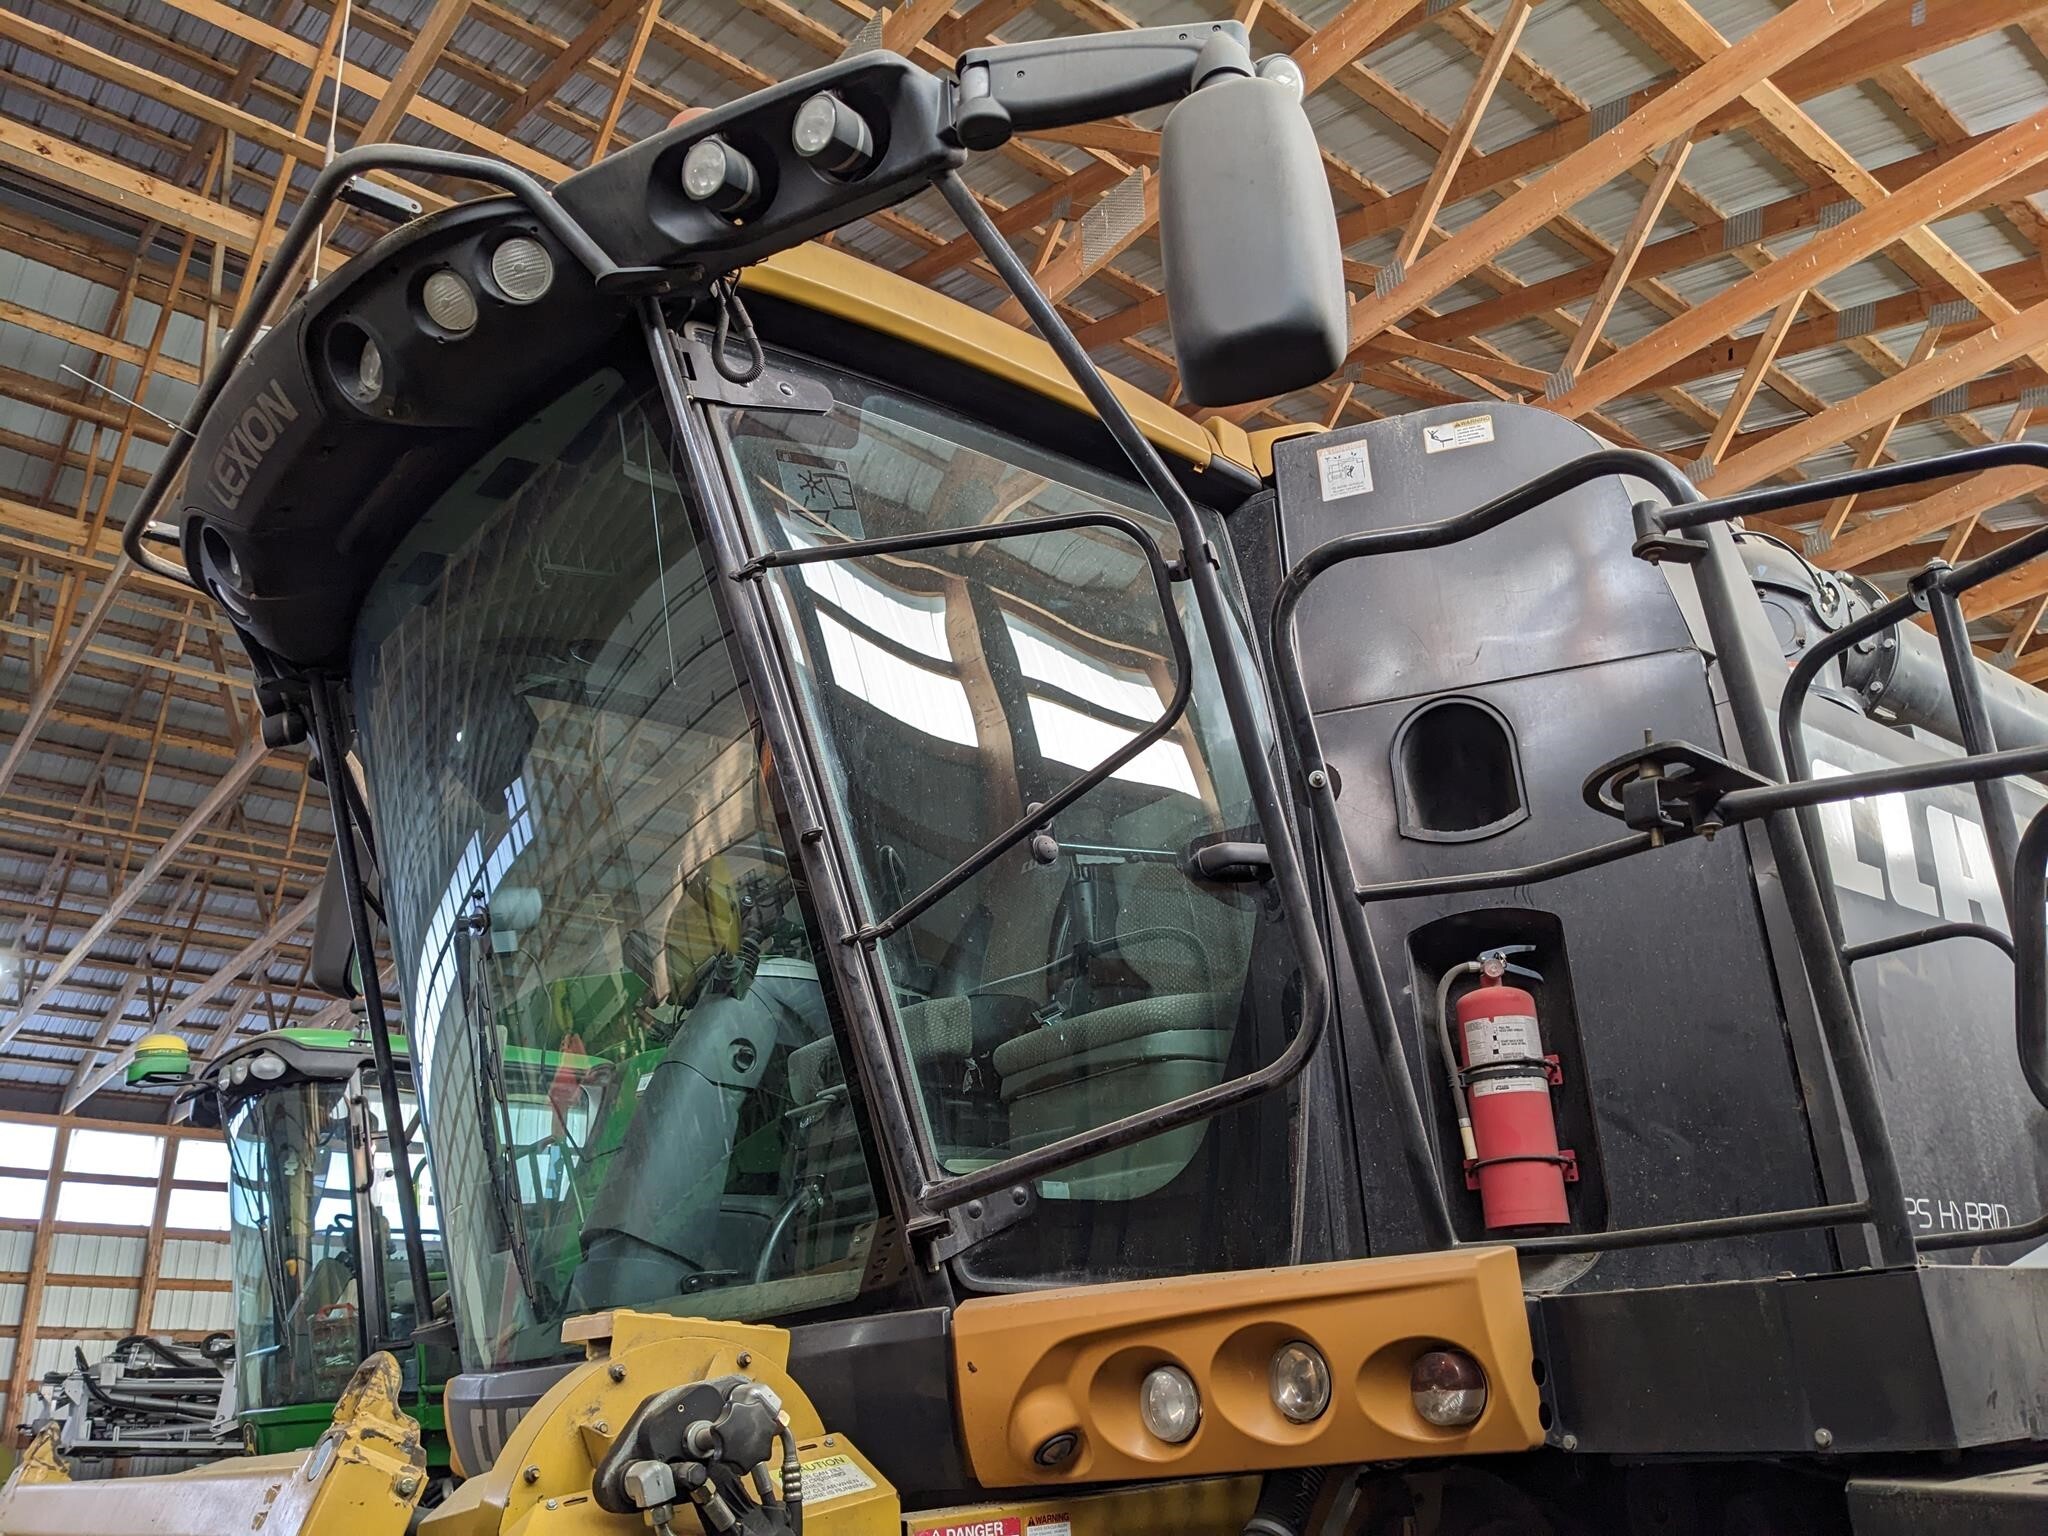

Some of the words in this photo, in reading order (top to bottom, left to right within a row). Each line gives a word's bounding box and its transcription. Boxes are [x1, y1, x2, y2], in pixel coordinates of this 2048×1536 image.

[1461, 416, 1490, 426] WARNING
[208, 379, 299, 510] LEXION
[1812, 758, 2013, 938] CLA
[1904, 1197, 1932, 1229] PS
[1938, 1200, 2010, 1231] HYBRID
[800, 1456, 844, 1471] AUTION
[1035, 1512, 1069, 1524] WARNING
[946, 1521, 1003, 1536] DANGER
